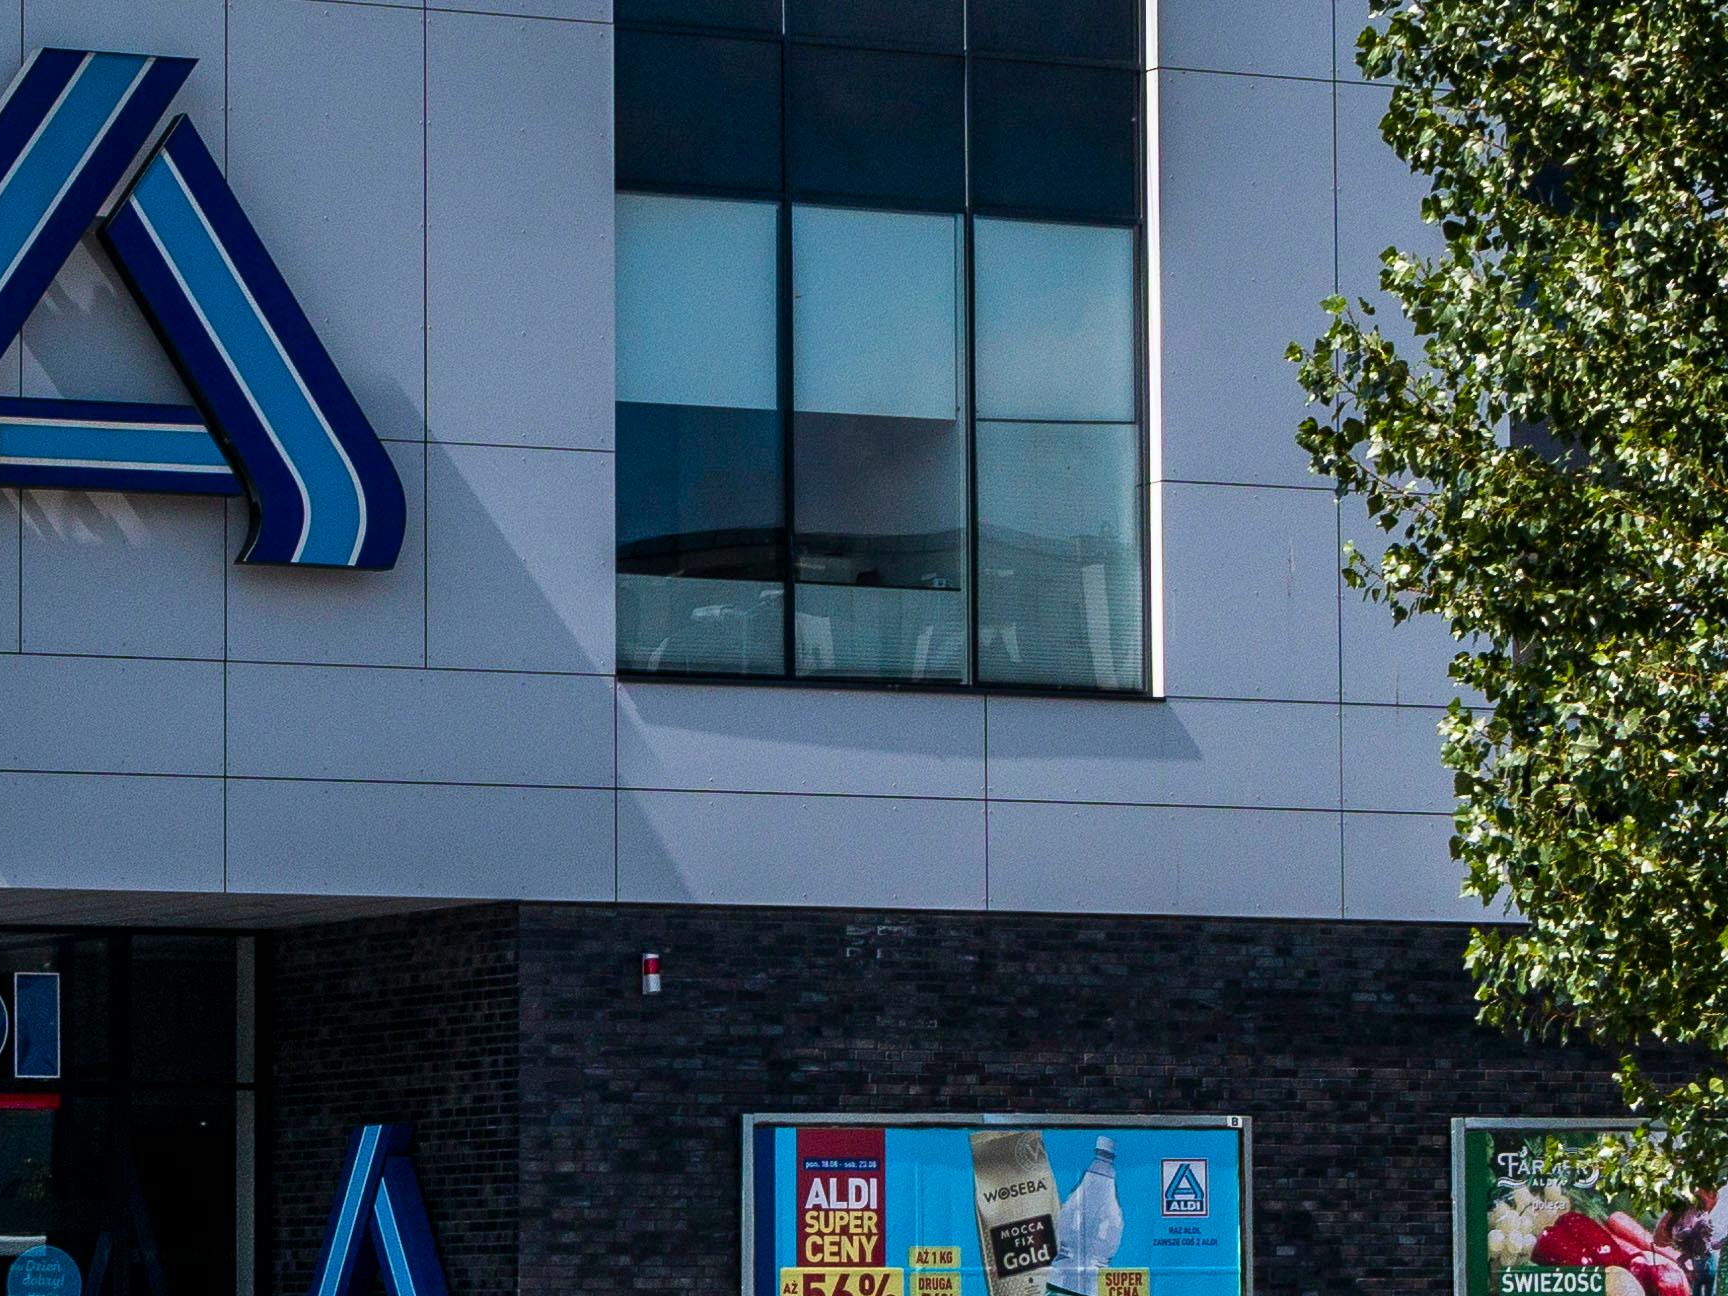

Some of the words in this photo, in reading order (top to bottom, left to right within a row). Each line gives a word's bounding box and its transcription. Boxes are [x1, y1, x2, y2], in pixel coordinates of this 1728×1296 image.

[805, 1178, 877, 1209] ALDI
[984, 1180, 1047, 1203] WOSEBA
[1169, 1201, 1201, 1211] ALDI
[805, 1211, 878, 1233] SUPER
[1000, 1221, 1044, 1239] MOCCA
[805, 1235, 878, 1262] CENY
[1015, 1235, 1035, 1247] FIX
[916, 1250, 930, 1264] AŻ
[932, 1251, 937, 1264] 1
[940, 1251, 953, 1264] KG
[1003, 1244, 1051, 1270] Gold
[783, 1280, 799, 1294] AŻ
[918, 1278, 953, 1290] DRUGA
[1105, 1273, 1143, 1286] SUPER
[1501, 1266, 1602, 1292] ŚWIEŻOŚĆ
